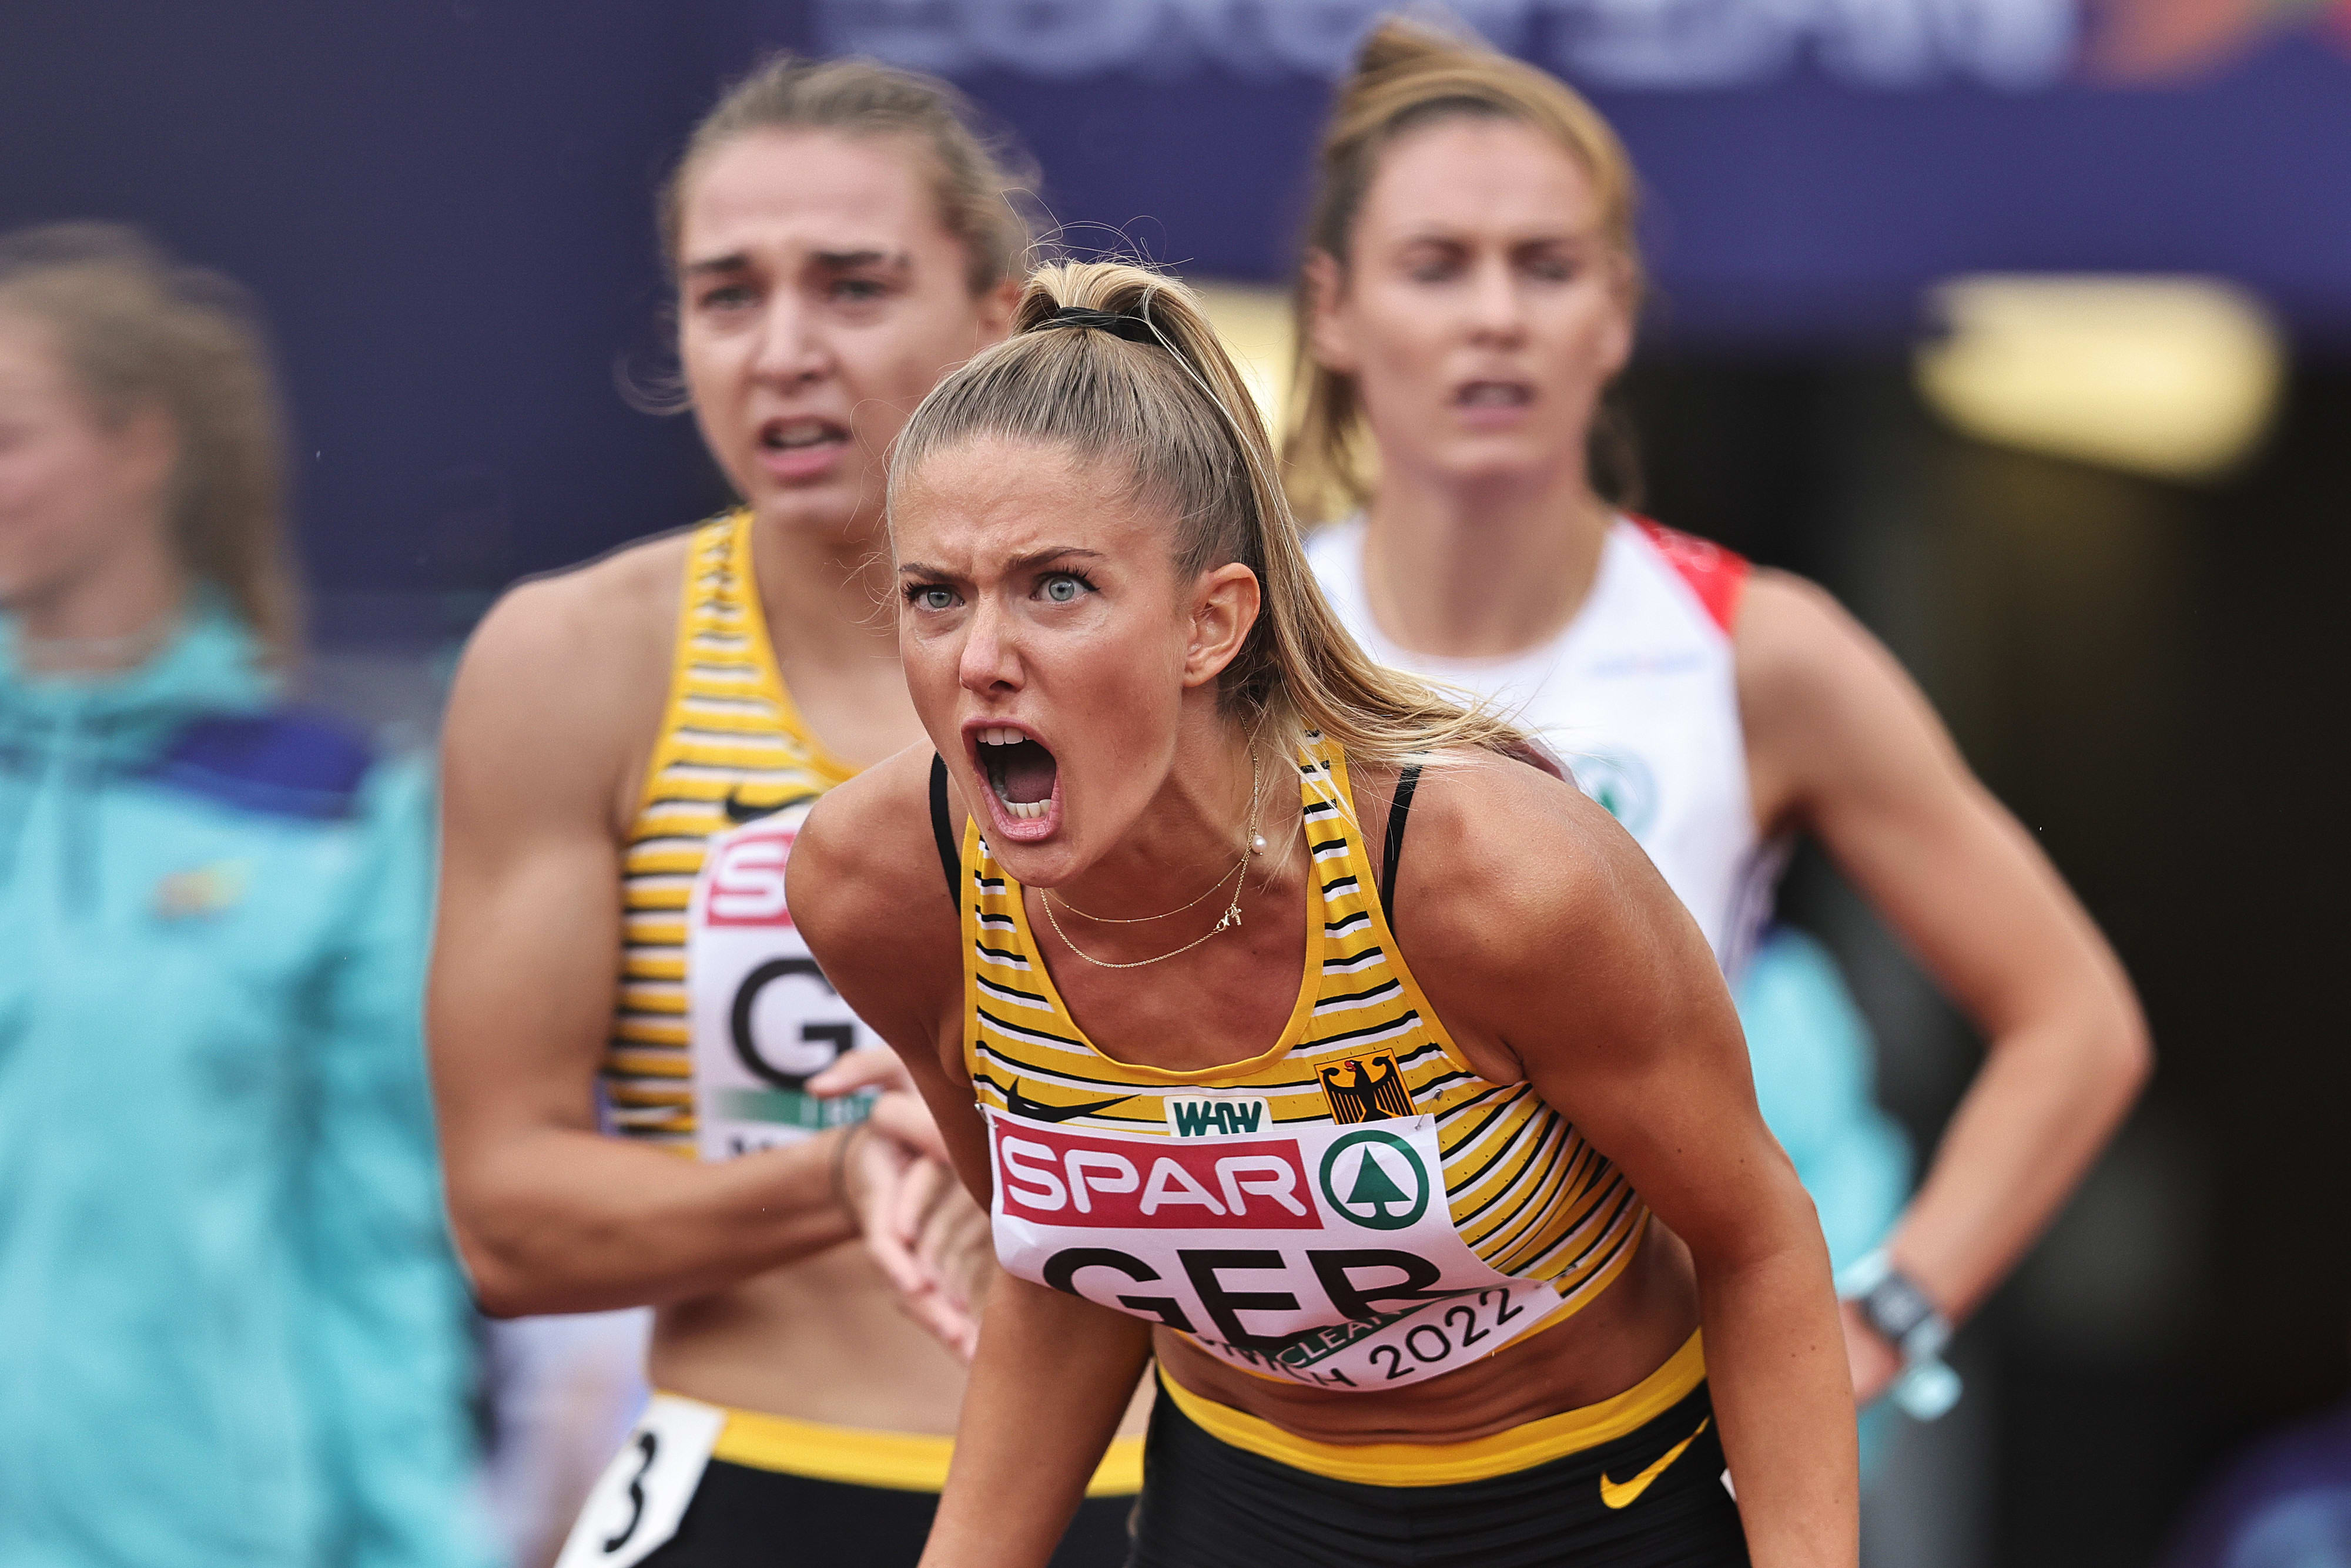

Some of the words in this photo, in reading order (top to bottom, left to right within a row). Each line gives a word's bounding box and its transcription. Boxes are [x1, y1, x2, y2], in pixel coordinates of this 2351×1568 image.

[1001, 1137, 1307, 1217] SPAR
[1043, 1247, 1463, 1350] GER
[1369, 1288, 1523, 1379] 2022
[603, 1431, 657, 1553] 3
